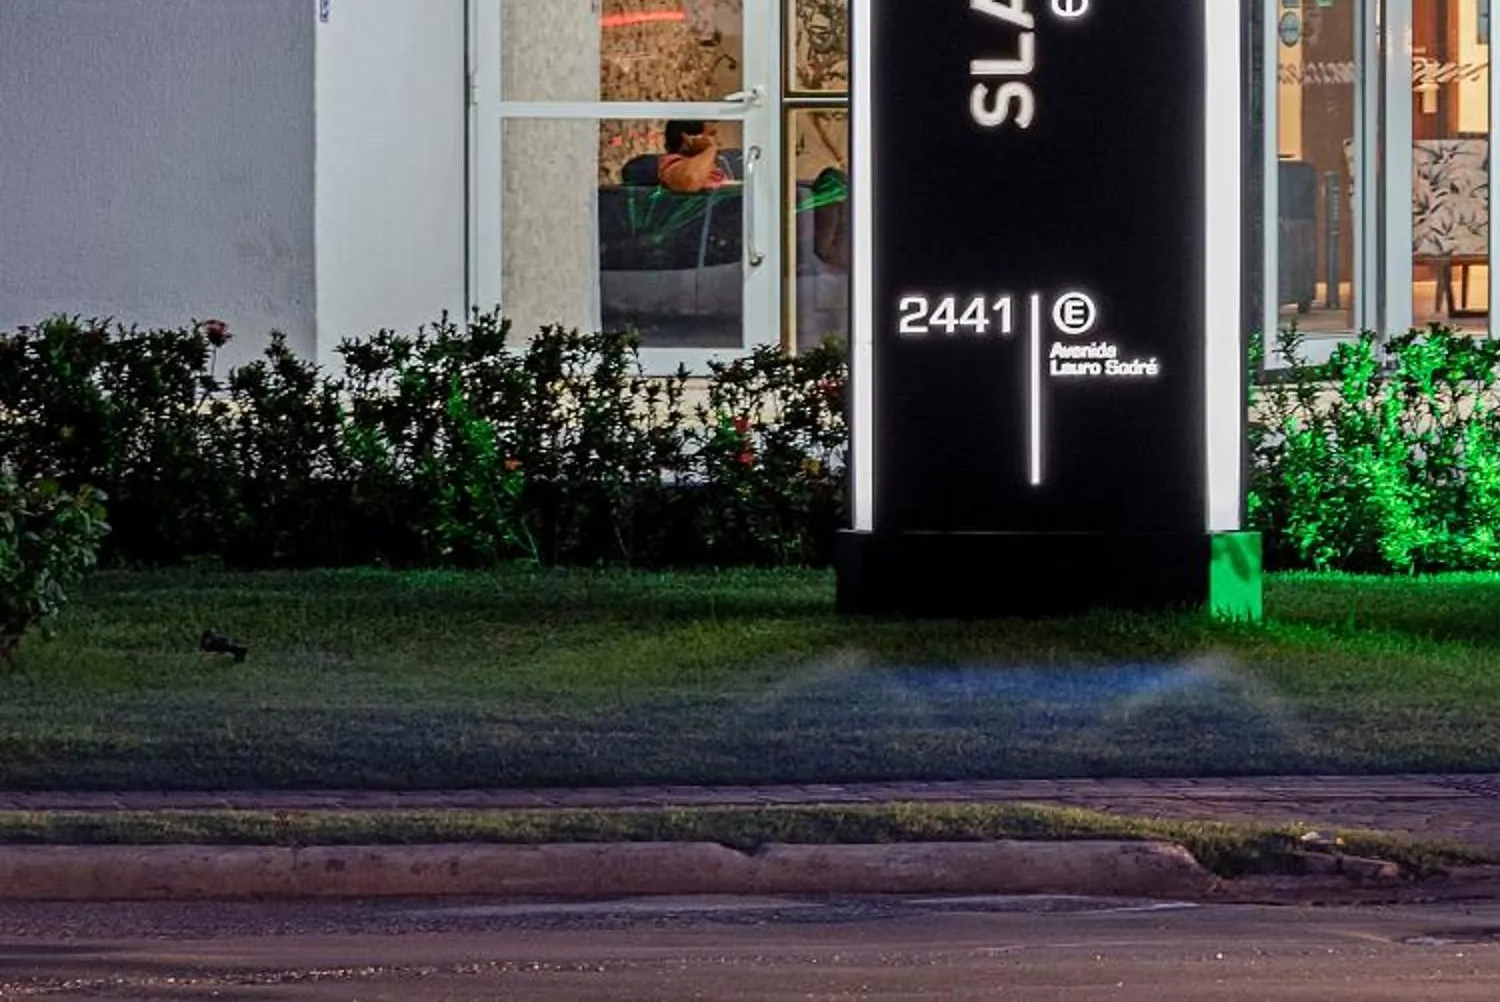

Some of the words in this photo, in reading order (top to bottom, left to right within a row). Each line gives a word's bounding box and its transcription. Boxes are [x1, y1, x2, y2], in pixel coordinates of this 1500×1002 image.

[899, 296, 1013, 333] 2441
[1050, 341, 1117, 359] Avenida
[1050, 359, 1103, 376] Lauro
[1104, 357, 1160, 376] Sodré
